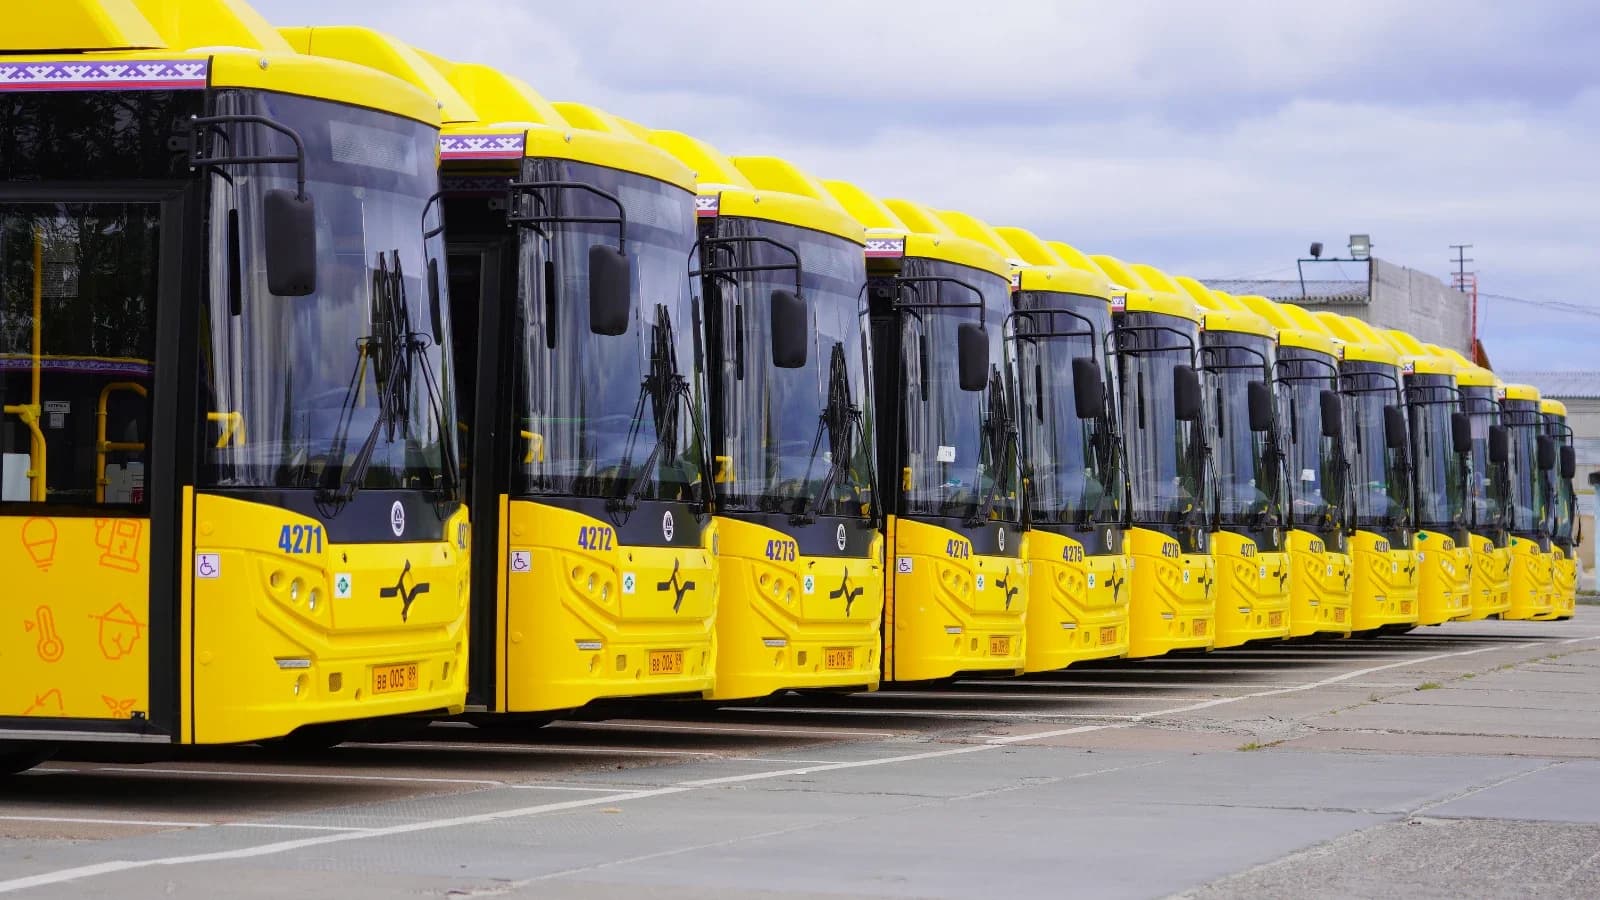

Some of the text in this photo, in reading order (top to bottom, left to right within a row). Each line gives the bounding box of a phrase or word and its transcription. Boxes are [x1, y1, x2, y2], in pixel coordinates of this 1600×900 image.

[278, 524, 322, 554] 4271
[578, 526, 612, 551] 4272
[946, 538, 969, 560] 4274
[765, 539, 795, 562] 4273
[1062, 545, 1083, 562] 4275
[390, 668, 405, 688] 005
[408, 665, 416, 681] 89
